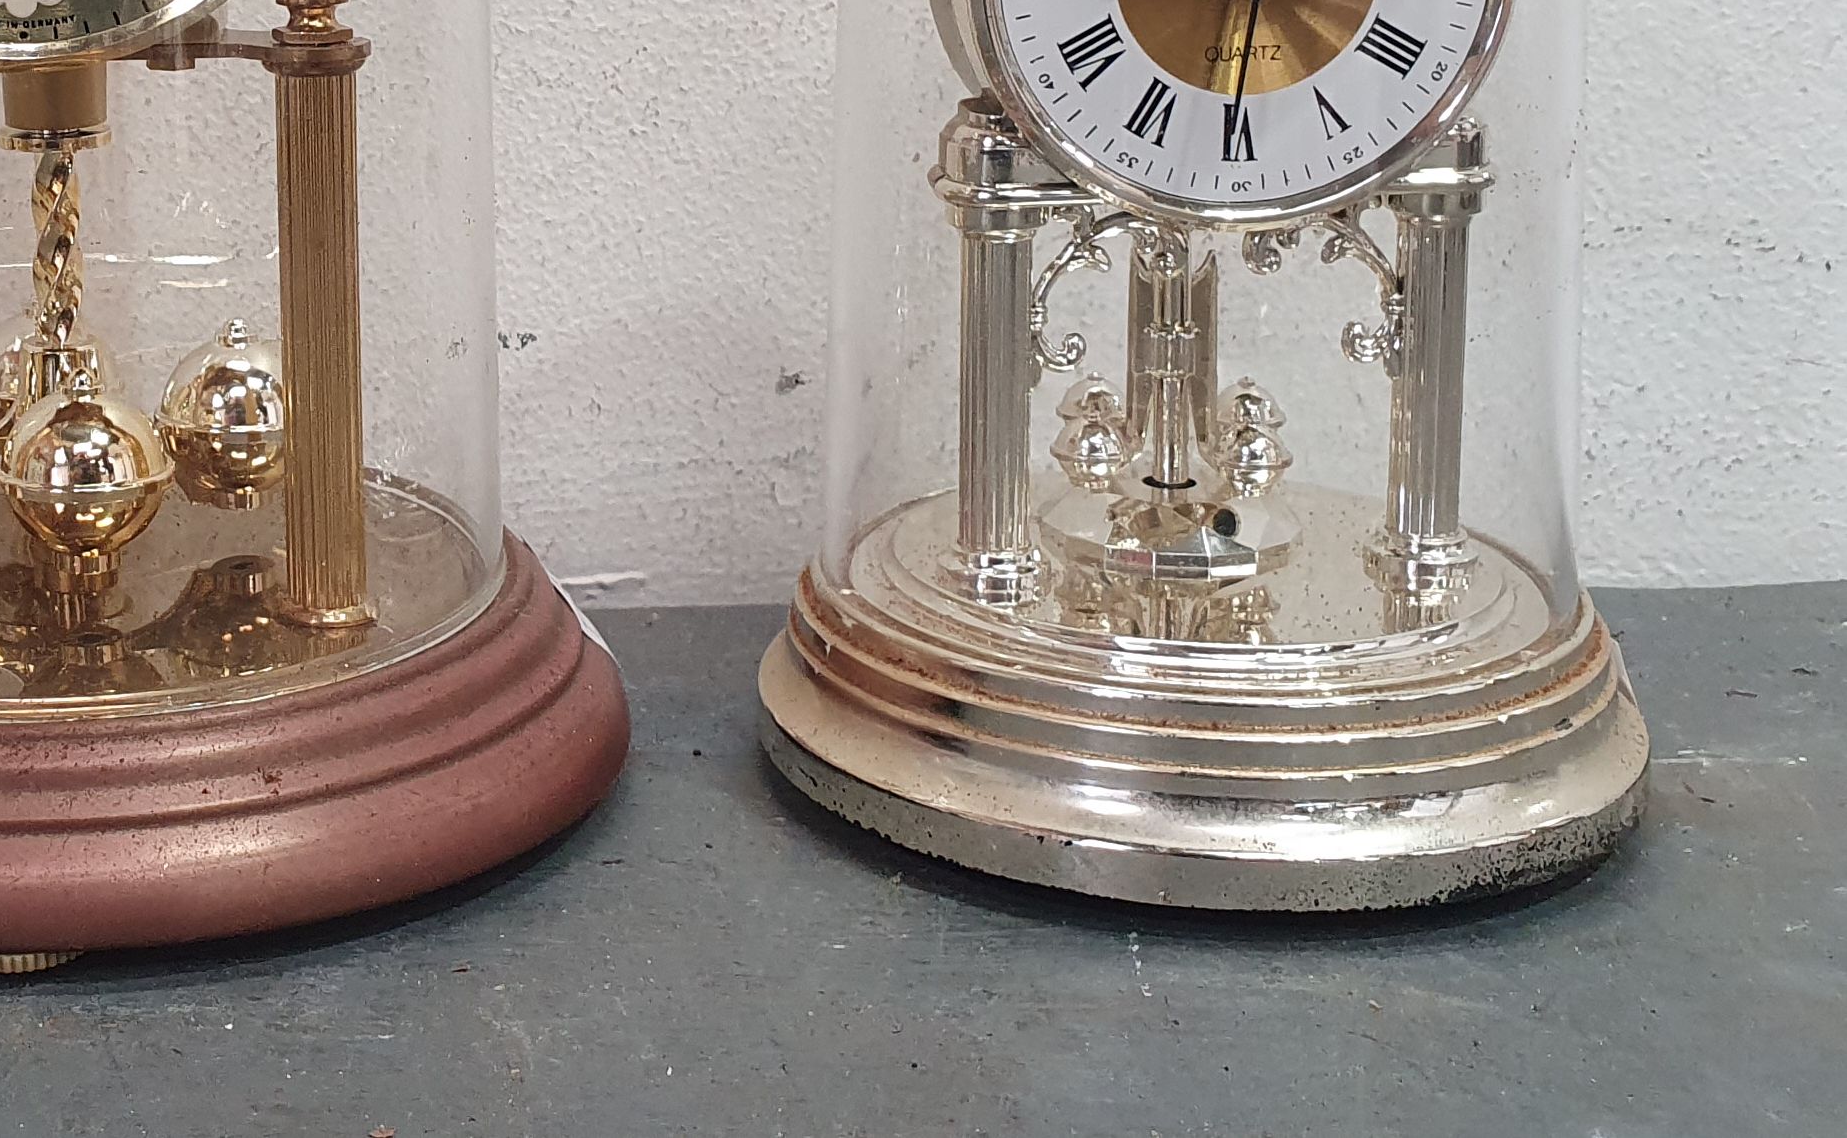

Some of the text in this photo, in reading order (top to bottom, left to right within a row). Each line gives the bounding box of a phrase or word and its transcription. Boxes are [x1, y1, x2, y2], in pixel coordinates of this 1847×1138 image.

[1057, 13, 1126, 92] VIII
[1205, 44, 1281, 62] QUARTZ
[1038, 73, 1055, 90] 40
[1431, 62, 1448, 82] 20
[1123, 76, 1180, 147] VII
[1312, 85, 1352, 140] V
[1221, 103, 1258, 162] VI
[1116, 152, 1139, 168] 35
[1342, 145, 1364, 162] 25
[1231, 180, 1252, 192] 30
